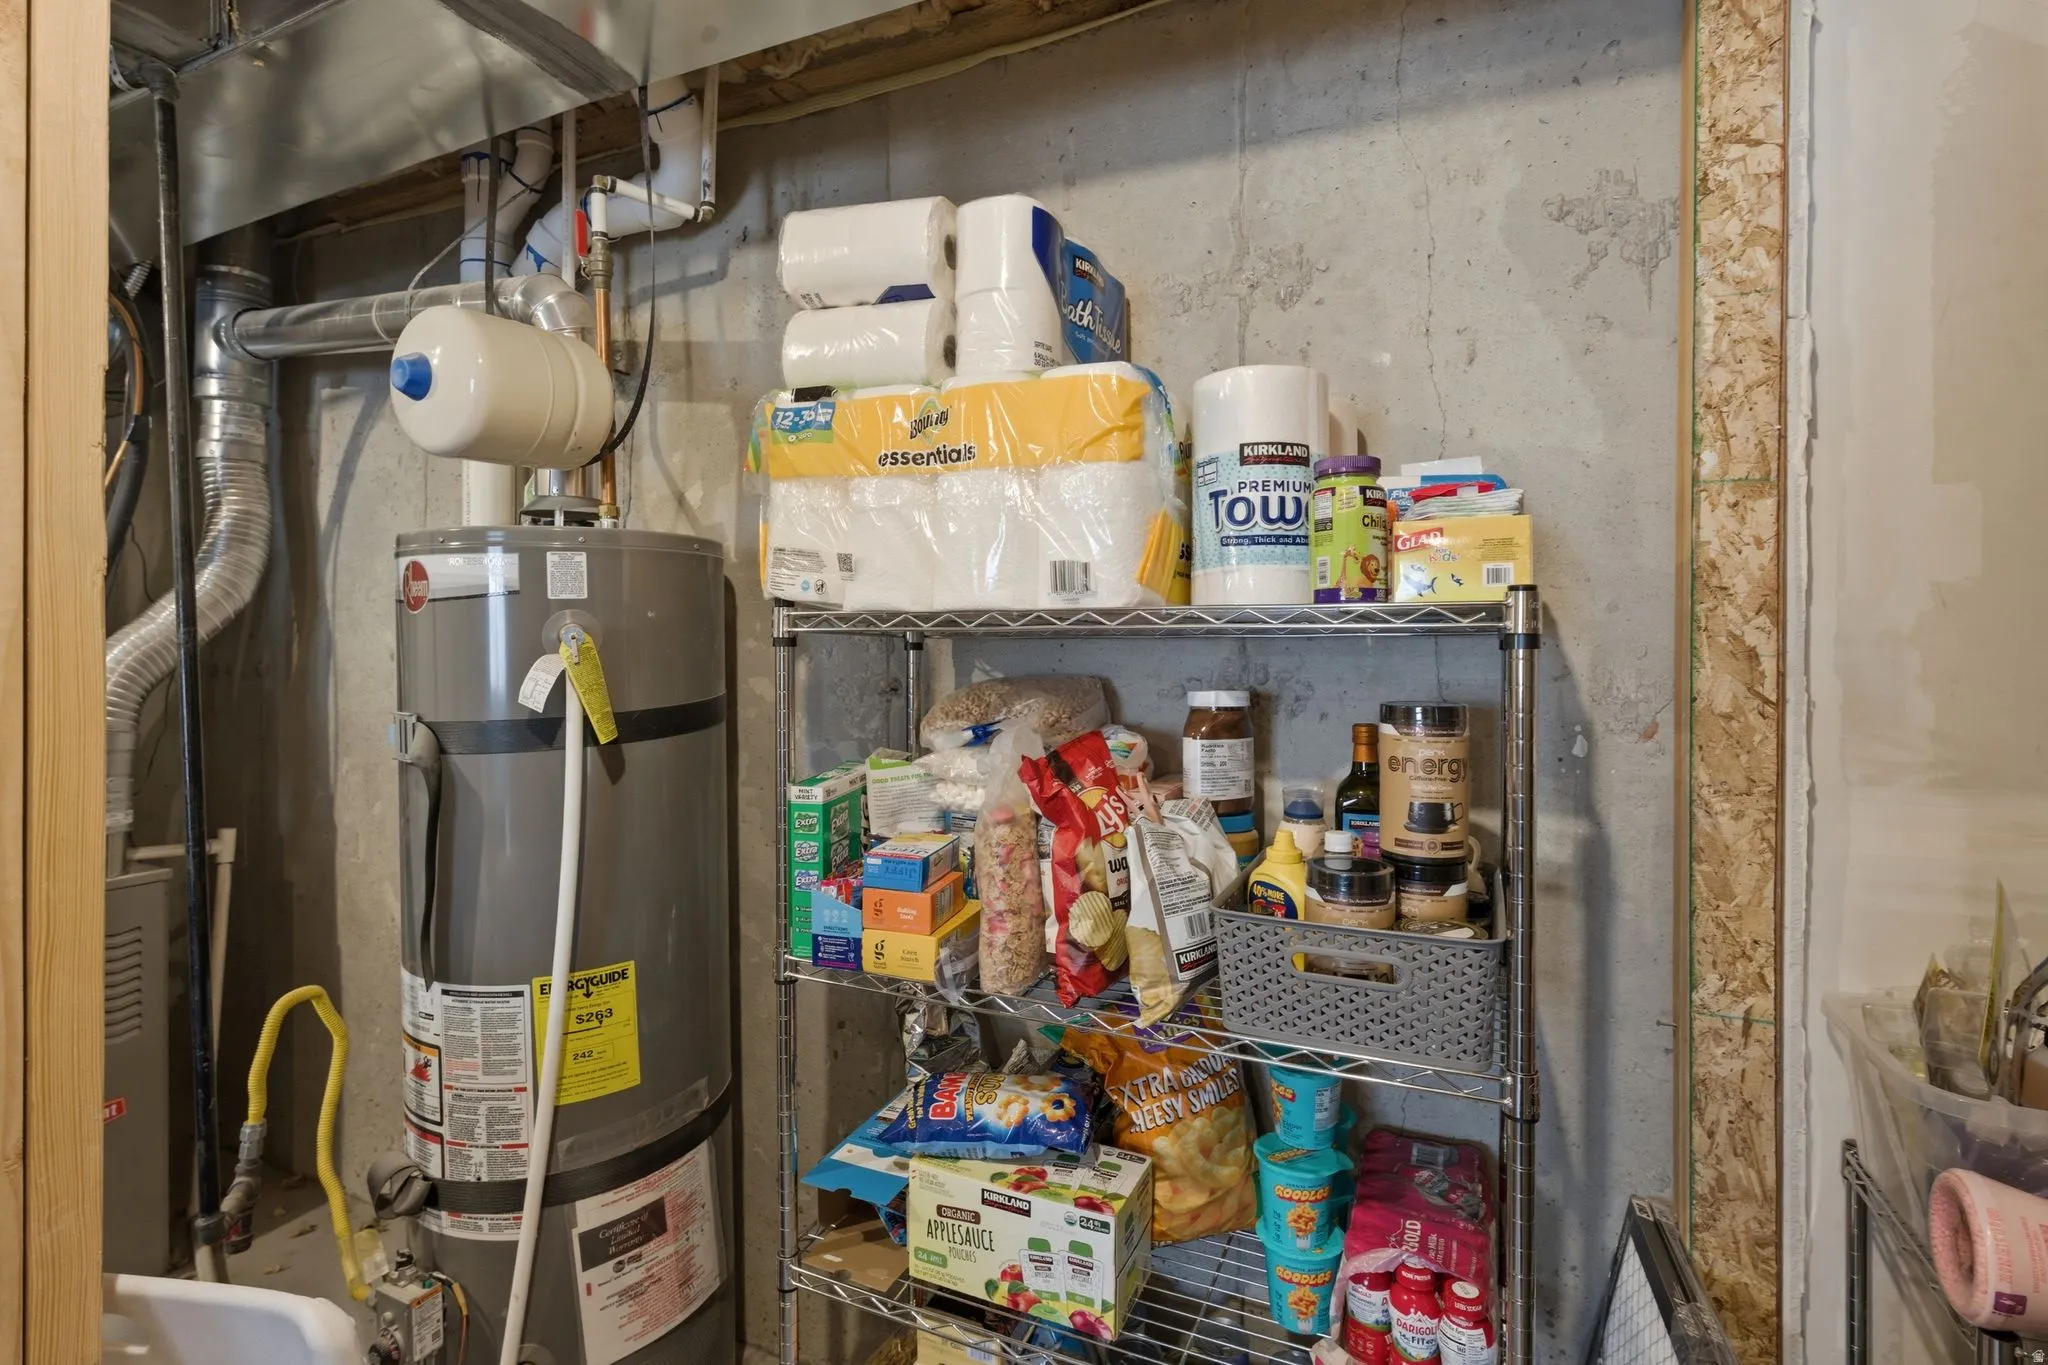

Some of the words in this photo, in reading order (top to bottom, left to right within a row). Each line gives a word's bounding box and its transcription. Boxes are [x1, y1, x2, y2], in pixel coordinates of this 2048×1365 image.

[1060, 281, 1095, 330] Bath
[1095, 305, 1121, 354] Tissue
[909, 406, 949, 440] Bounty
[878, 443, 975, 467] essentials
[1243, 444, 1308, 457] KIRKLAND
[1238, 480, 1311, 493] PREMIUM
[1254, 536, 1275, 544] Thick
[1280, 536, 1293, 544] and
[1397, 531, 1441, 551] GLAD
[404, 560, 427, 604] Rheem
[1388, 755, 1467, 783] energy
[795, 817, 817, 829] Extra
[795, 846, 818, 858] Extra
[796, 874, 818, 886] Extra
[1268, 889, 1285, 900] MORE
[540, 968, 629, 995] ERGYGUIDE
[572, 1050, 594, 1060] 242
[1180, 1053, 1236, 1088] CHEDDA
[1130, 1094, 1183, 1133] HEESY
[1188, 1067, 1240, 1114] SMILES
[983, 1190, 1030, 1210] KIRKLAND
[1275, 1185, 1329, 1201] GOODLES
[941, 1207, 975, 1222] ORGANIC
[1080, 1217, 1095, 1230] 24
[600, 1213, 643, 1239] Certificate
[926, 1218, 995, 1252] APPLESAUCE
[609, 1235, 644, 1255] Warranty
[948, 1246, 977, 1263] POUCHES
[1276, 1265, 1332, 1285] GOODLES
[1411, 1335, 1425, 1345] FIT
